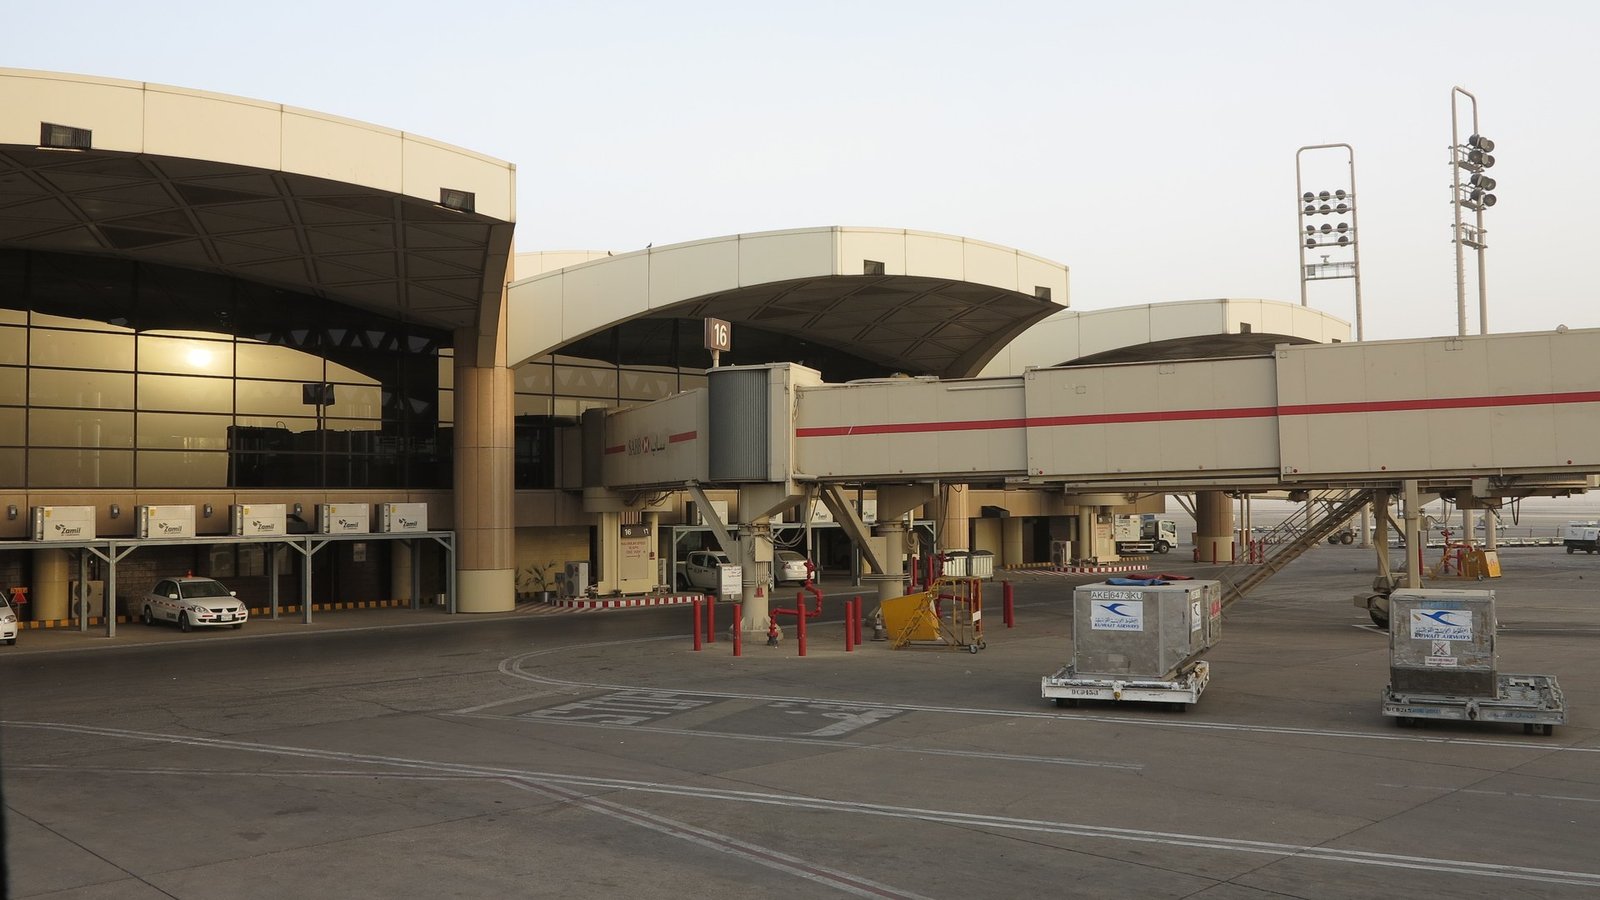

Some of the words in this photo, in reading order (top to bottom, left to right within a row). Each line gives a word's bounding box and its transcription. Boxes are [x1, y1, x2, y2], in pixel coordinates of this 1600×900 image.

[714, 323, 727, 346] 16
[624, 528, 632, 536] 16
[1091, 591, 1108, 599] AKE
[1110, 591, 1130, 600] 6473
[1130, 592, 1143, 600] KU
